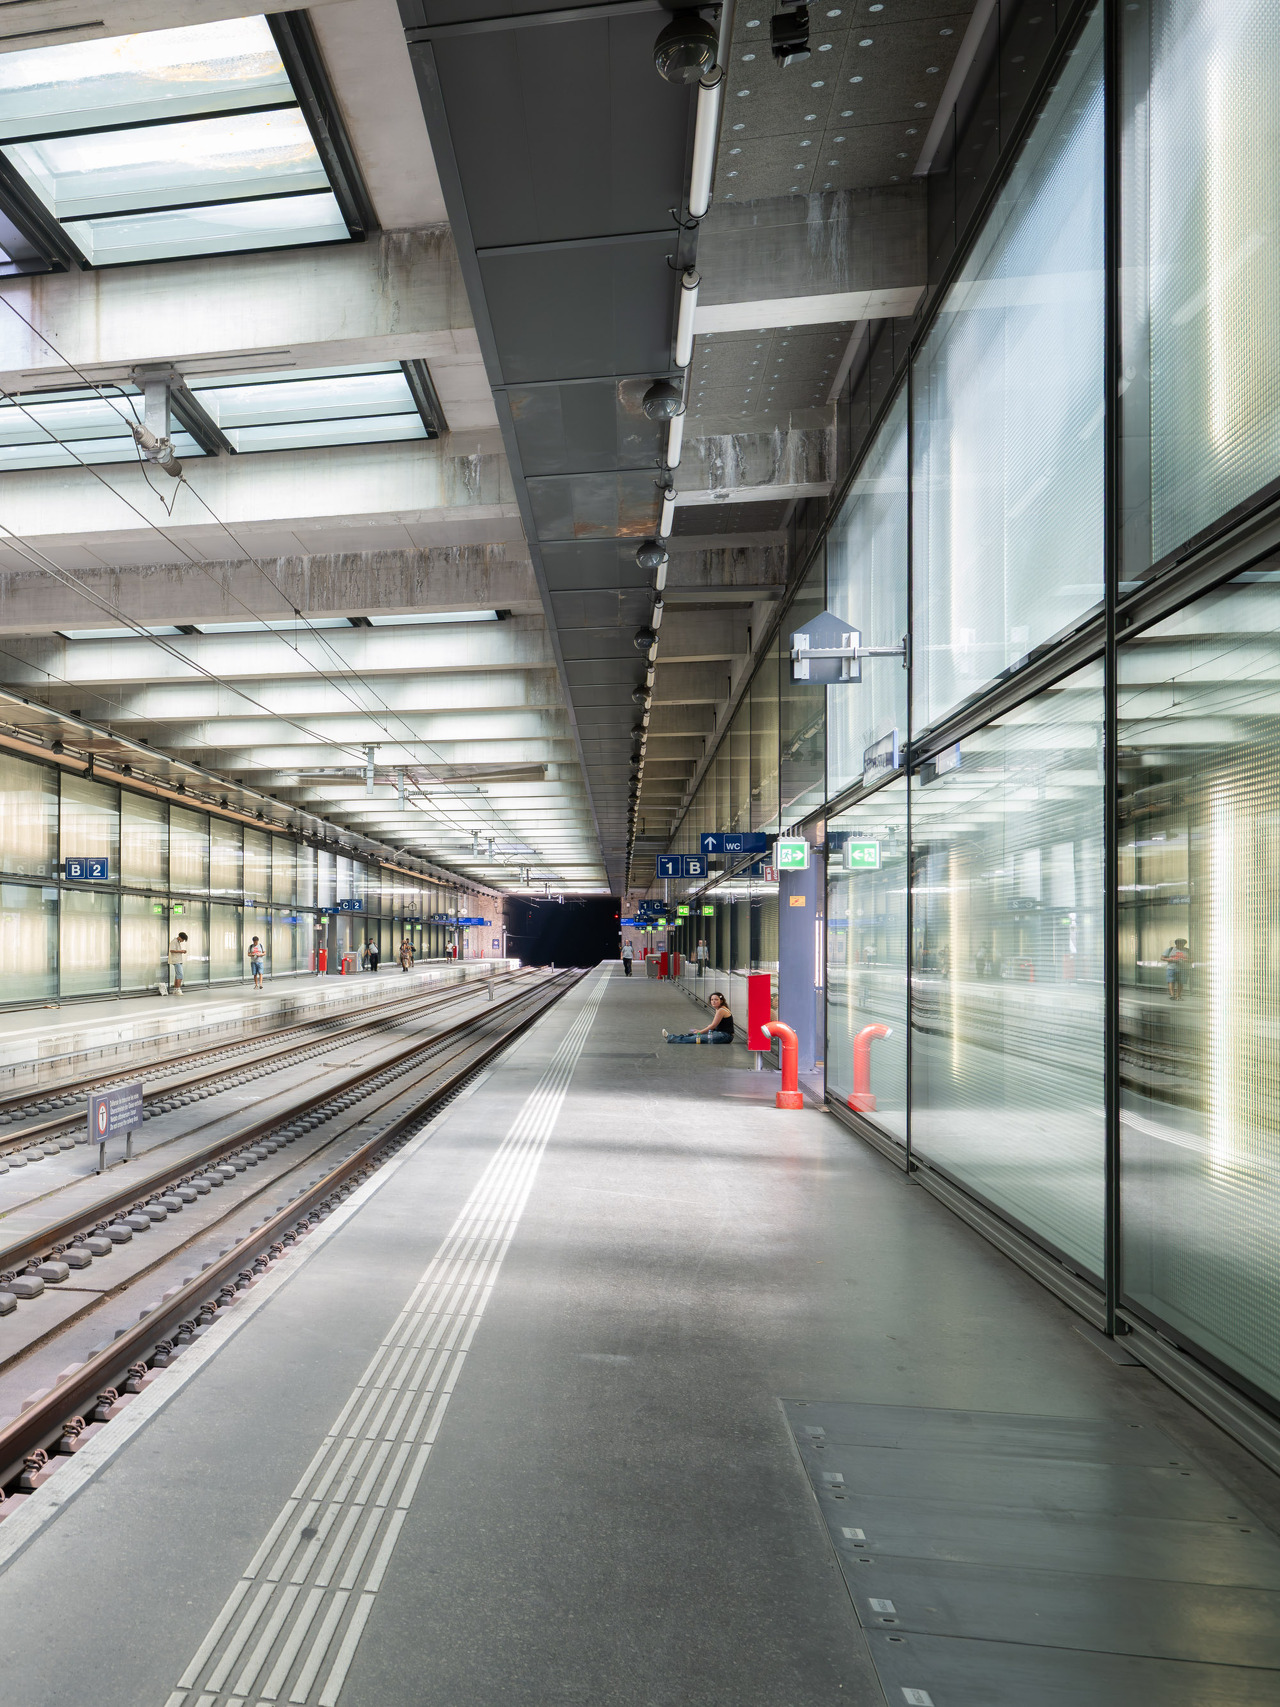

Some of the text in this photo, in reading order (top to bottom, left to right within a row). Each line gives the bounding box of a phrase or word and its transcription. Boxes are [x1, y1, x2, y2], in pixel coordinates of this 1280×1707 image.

[71, 864, 101, 876] B 2
[666, 862, 700, 874] 1 B
